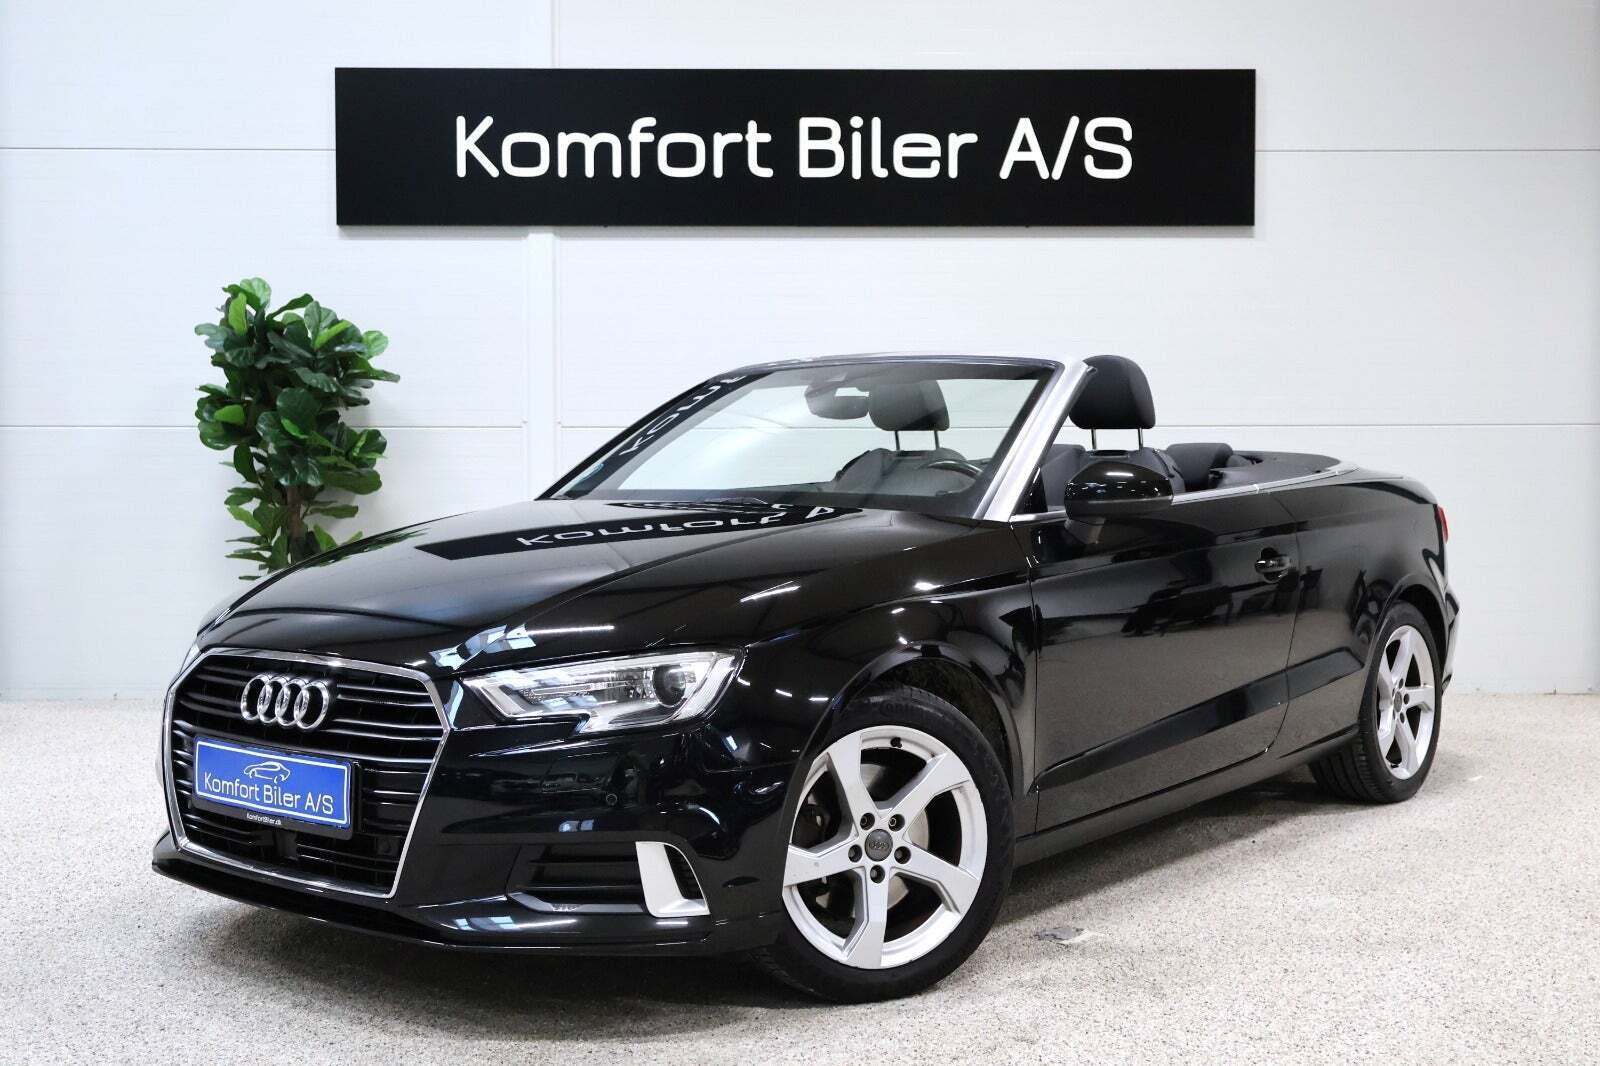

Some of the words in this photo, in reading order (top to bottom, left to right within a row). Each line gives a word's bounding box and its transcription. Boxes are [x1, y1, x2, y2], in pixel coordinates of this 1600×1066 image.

[455, 115, 773, 178] Komfort
[798, 115, 978, 179] Biler
[999, 116, 1132, 180] A/S
[204, 771, 260, 802] Komfort
[263, 785, 301, 808] Biler
[304, 792, 334, 815] A/S
